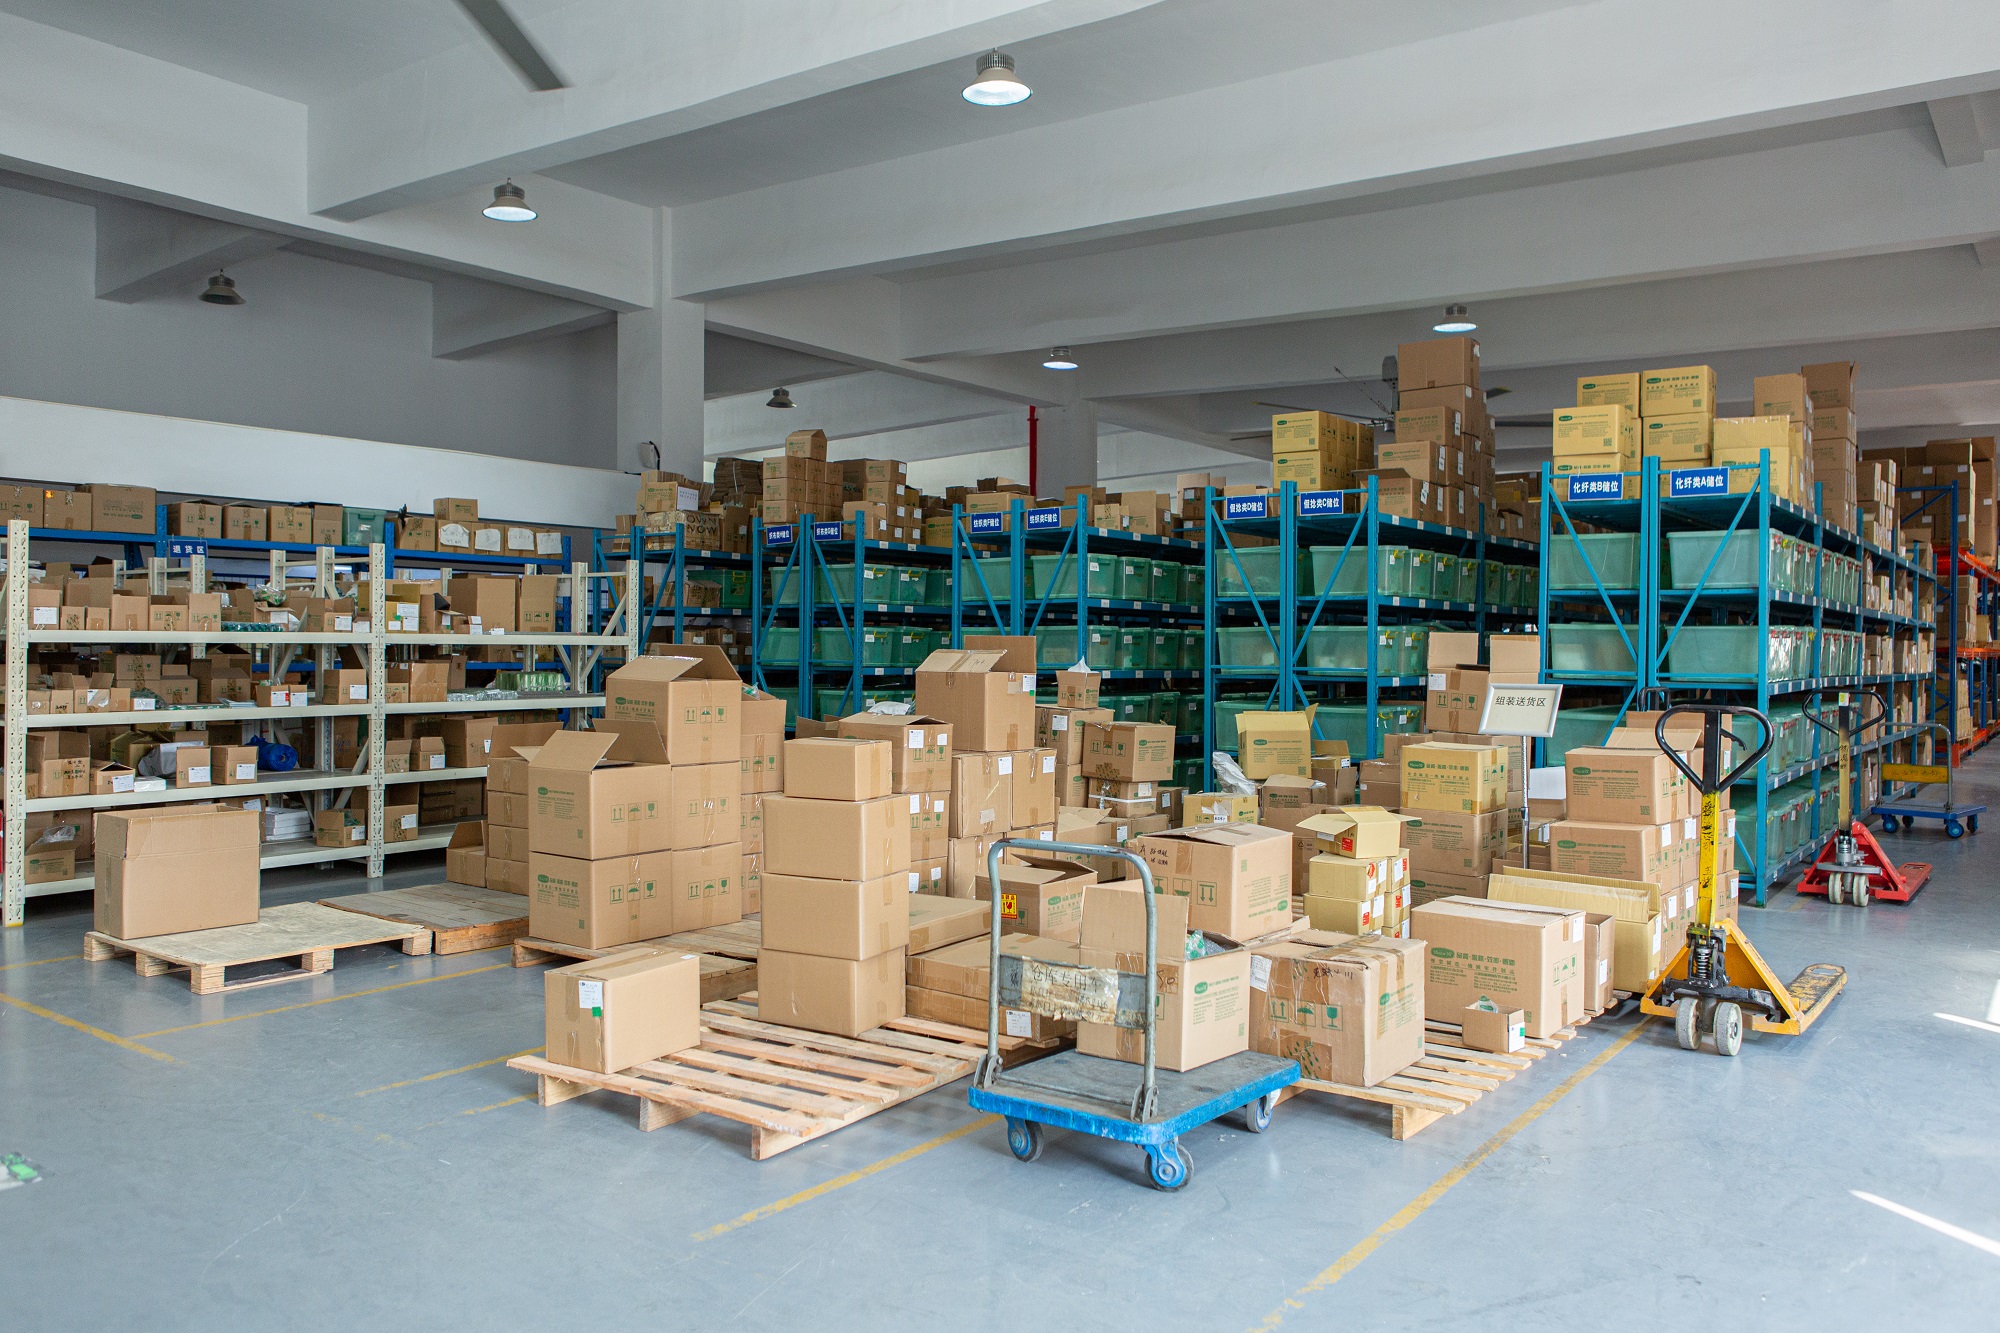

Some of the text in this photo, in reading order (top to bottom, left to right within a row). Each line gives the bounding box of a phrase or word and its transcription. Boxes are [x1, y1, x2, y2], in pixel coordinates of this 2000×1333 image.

[1573, 480, 1619, 494] 化纤类B储位
[1675, 474, 1724, 490] 化纤类A储位
[1495, 695, 1546, 707] 组装送货区
